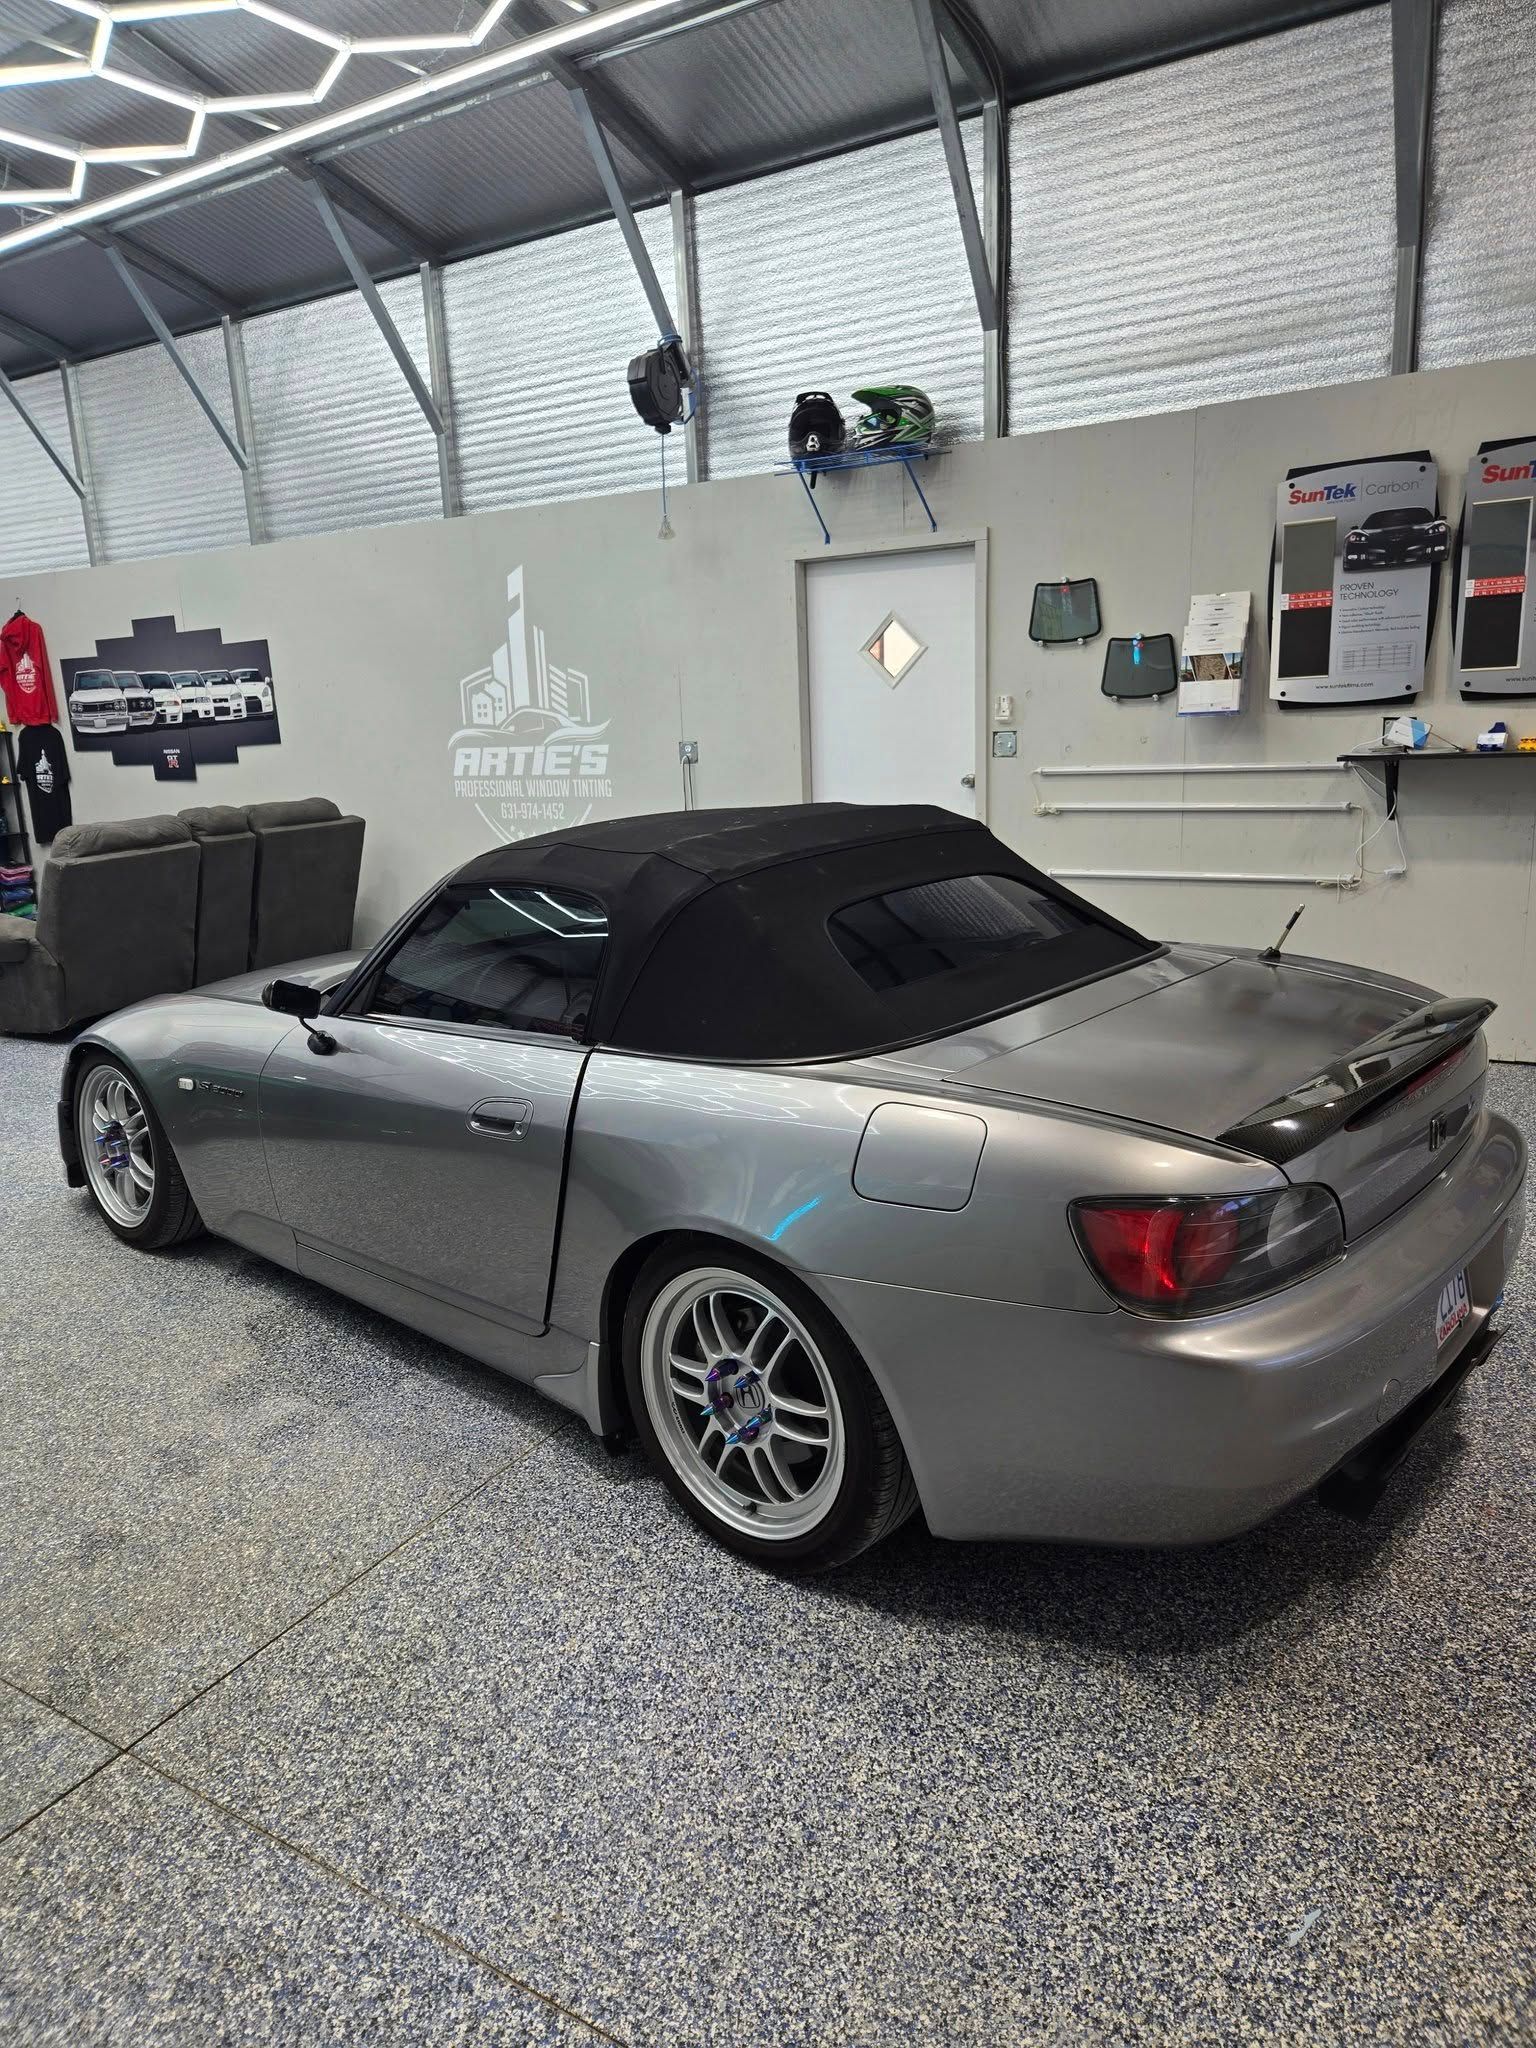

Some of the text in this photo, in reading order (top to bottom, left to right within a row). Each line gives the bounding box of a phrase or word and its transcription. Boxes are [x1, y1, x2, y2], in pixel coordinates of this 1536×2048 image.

[1289, 481, 1420, 505] SunTek Carbon
[1340, 582, 1375, 591] PROVEN
[1340, 589, 1399, 600] TECHNOLOGY
[453, 745, 609, 776] ARTIE'S
[455, 778, 613, 797] PROFESSIONAL WINDOW TINTING
[500, 802, 565, 820] 631-974-1452
